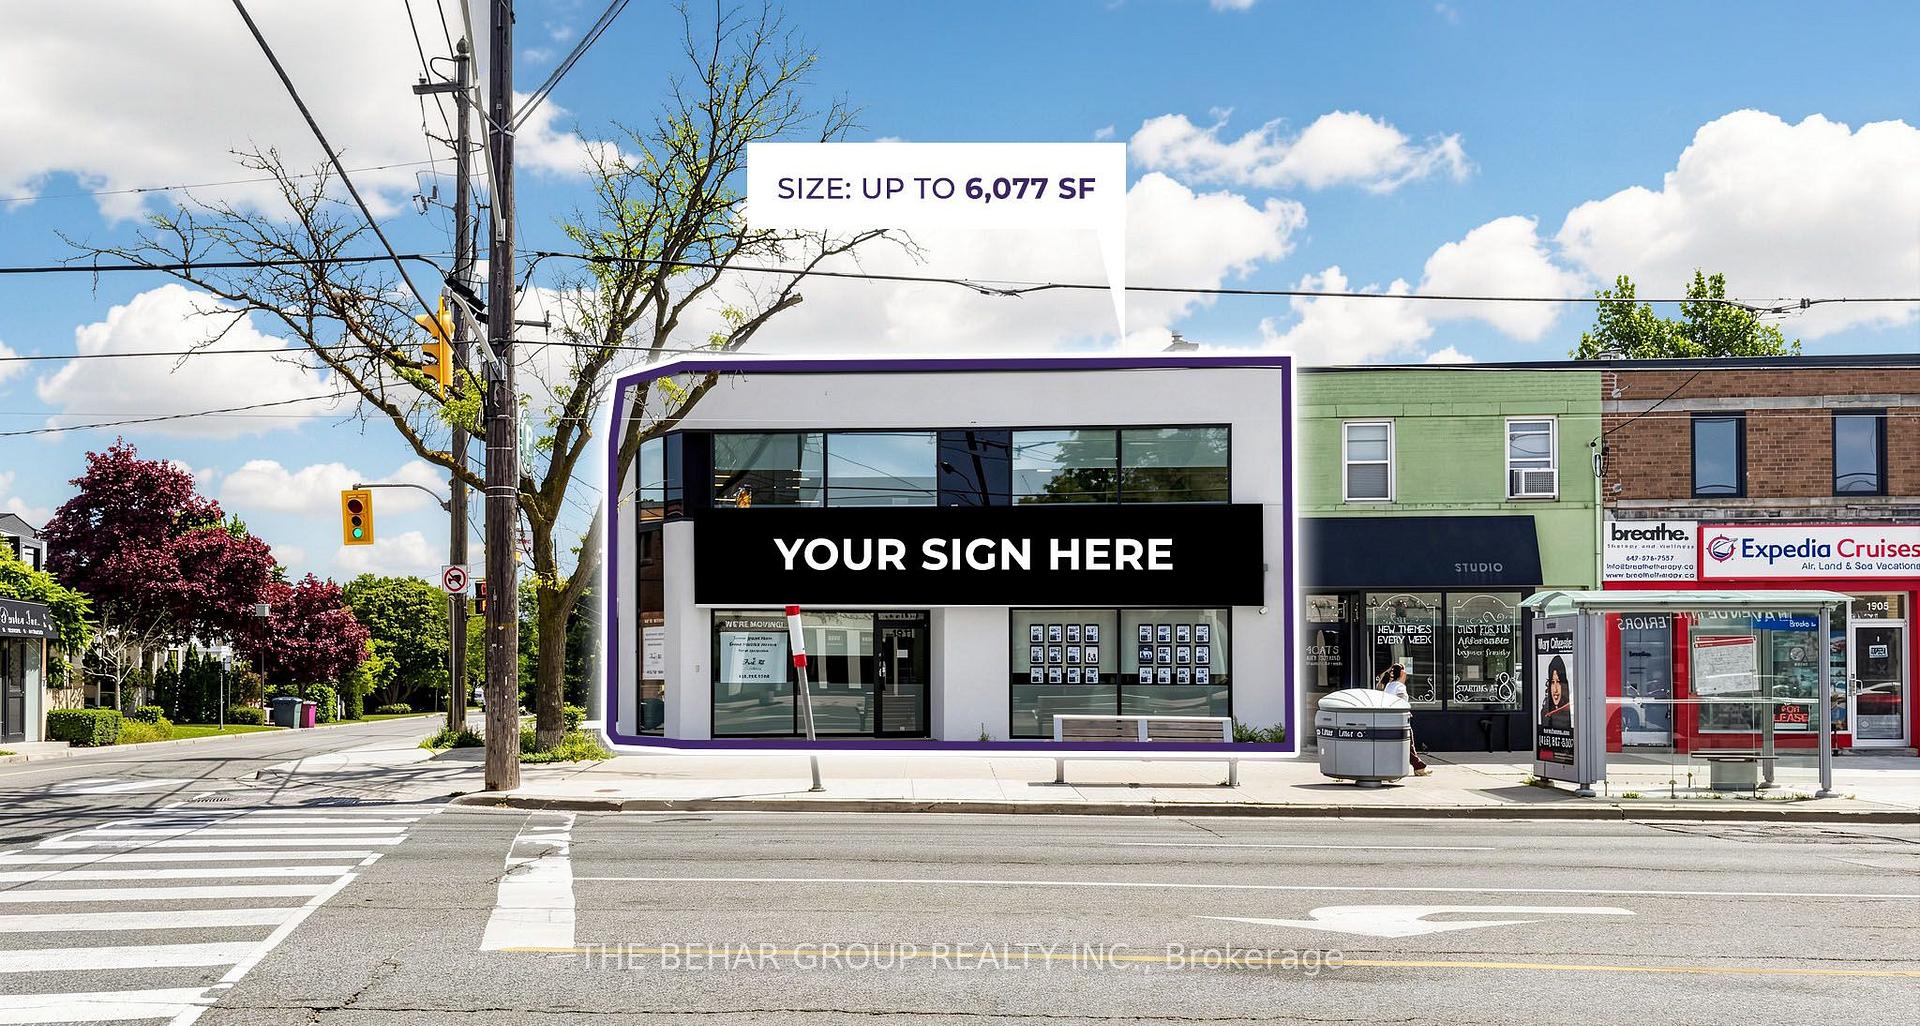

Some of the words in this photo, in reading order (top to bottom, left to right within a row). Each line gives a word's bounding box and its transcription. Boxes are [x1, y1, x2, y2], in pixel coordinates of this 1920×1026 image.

[1611, 523, 1689, 541] breathe.
[1742, 538, 1831, 564] Expedia
[1837, 538, 1920, 558] Cruises
[1454, 563, 1503, 573] STUDIO
[1818, 562, 1842, 570] Land
[1845, 562, 1852, 570] &
[1867, 602, 1889, 611] 1905
[1377, 625, 1395, 634] NEW
[1399, 625, 1432, 634] THEMES
[1457, 625, 1477, 634] JUST
[1496, 625, 1511, 633] FUN
[1377, 636, 1405, 645] EVERY
[1408, 636, 1432, 644] WEEK
[1774, 713, 1808, 723] LEASE
